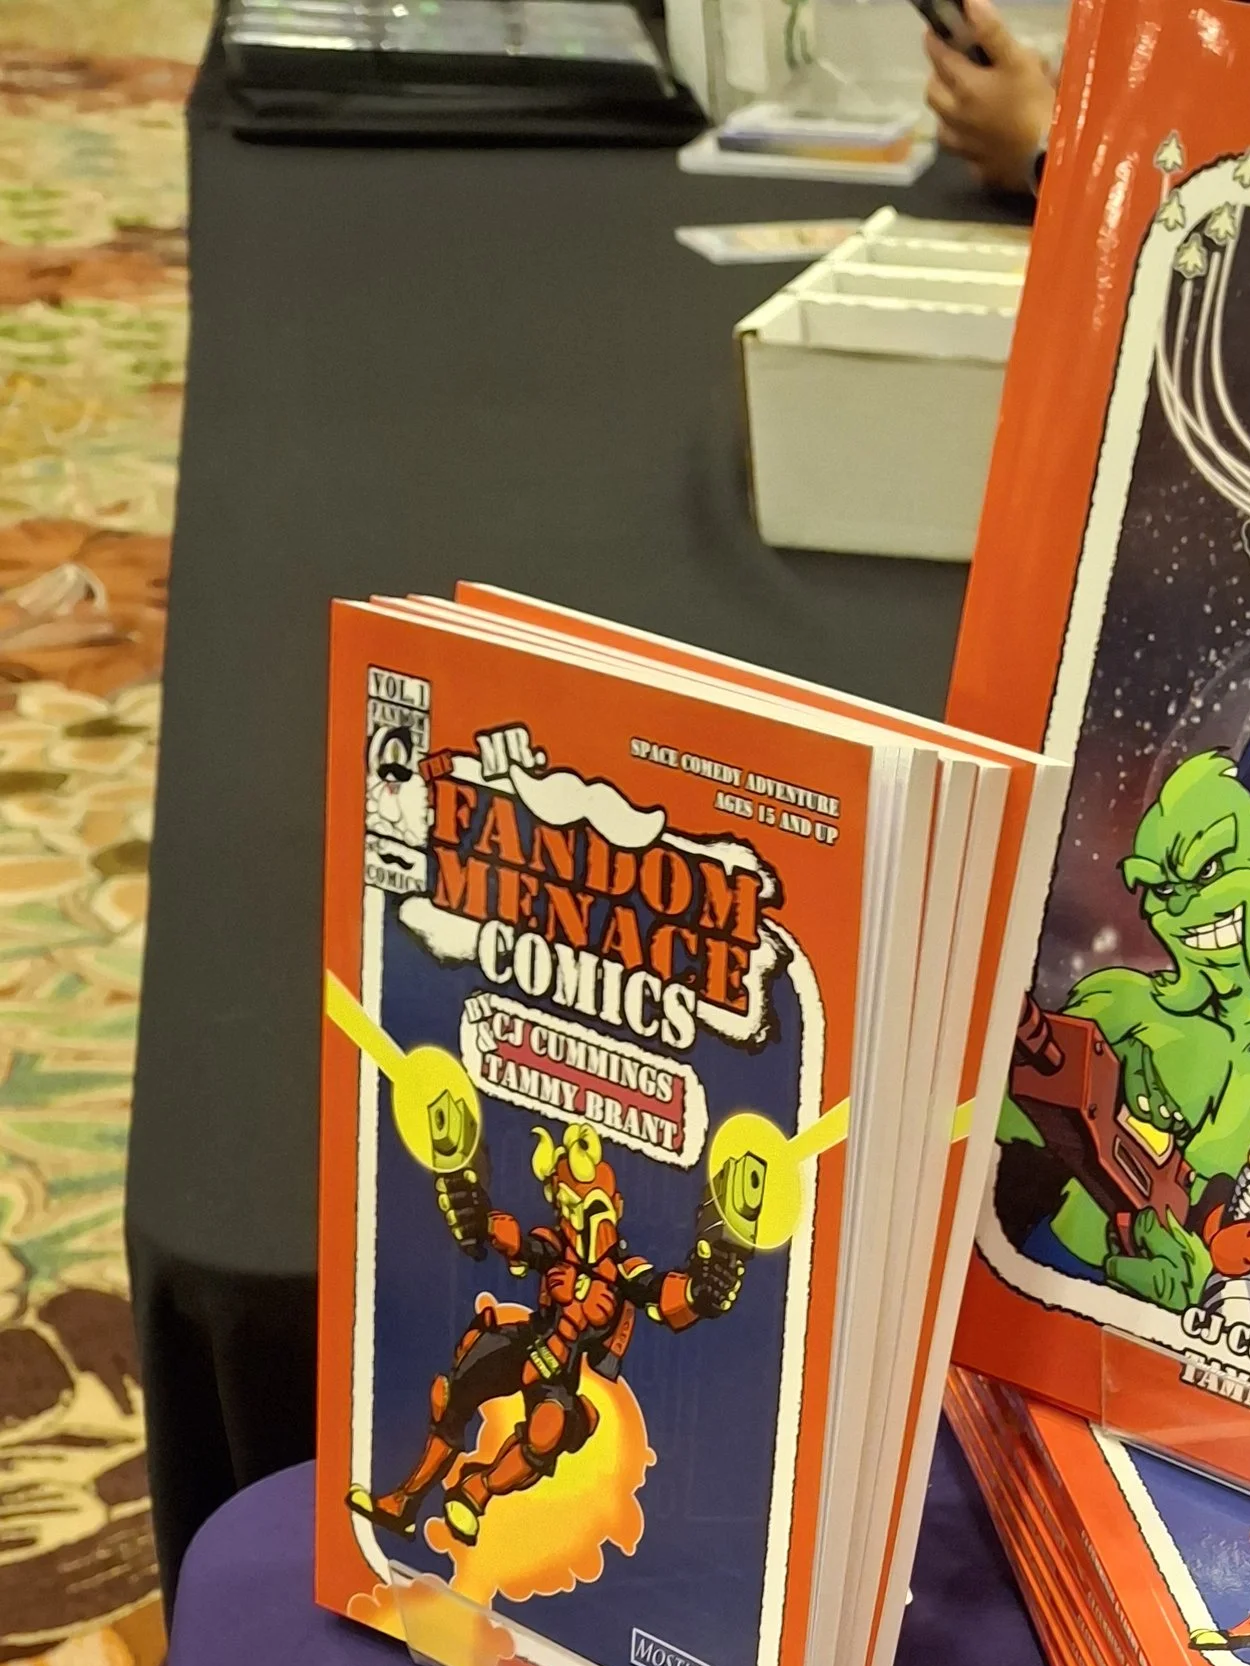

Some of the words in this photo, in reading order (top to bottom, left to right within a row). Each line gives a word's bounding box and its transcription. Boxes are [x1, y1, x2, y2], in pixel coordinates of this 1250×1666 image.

[477, 725, 547, 779] MR.
[631, 738, 679, 768] SPACE
[681, 753, 743, 787] COMEDY
[745, 773, 840, 818] ADVENTURE
[715, 791, 754, 819] AGES
[758, 804, 776, 825] 15
[780, 811, 812, 837] AND
[815, 823, 839, 845] UP
[433, 781, 759, 942] FANDOM
[433, 849, 749, 1010] MENACE
[464, 994, 493, 1023] BY
[478, 920, 698, 1050] COMICS
[476, 1020, 498, 1053] &
[492, 1012, 526, 1047] CJ
[530, 1026, 674, 1103] CUMMINGS
[485, 1053, 580, 1112] TAMMY
[585, 1089, 679, 1151] BRANT
[1181, 1307, 1225, 1344] CJ
